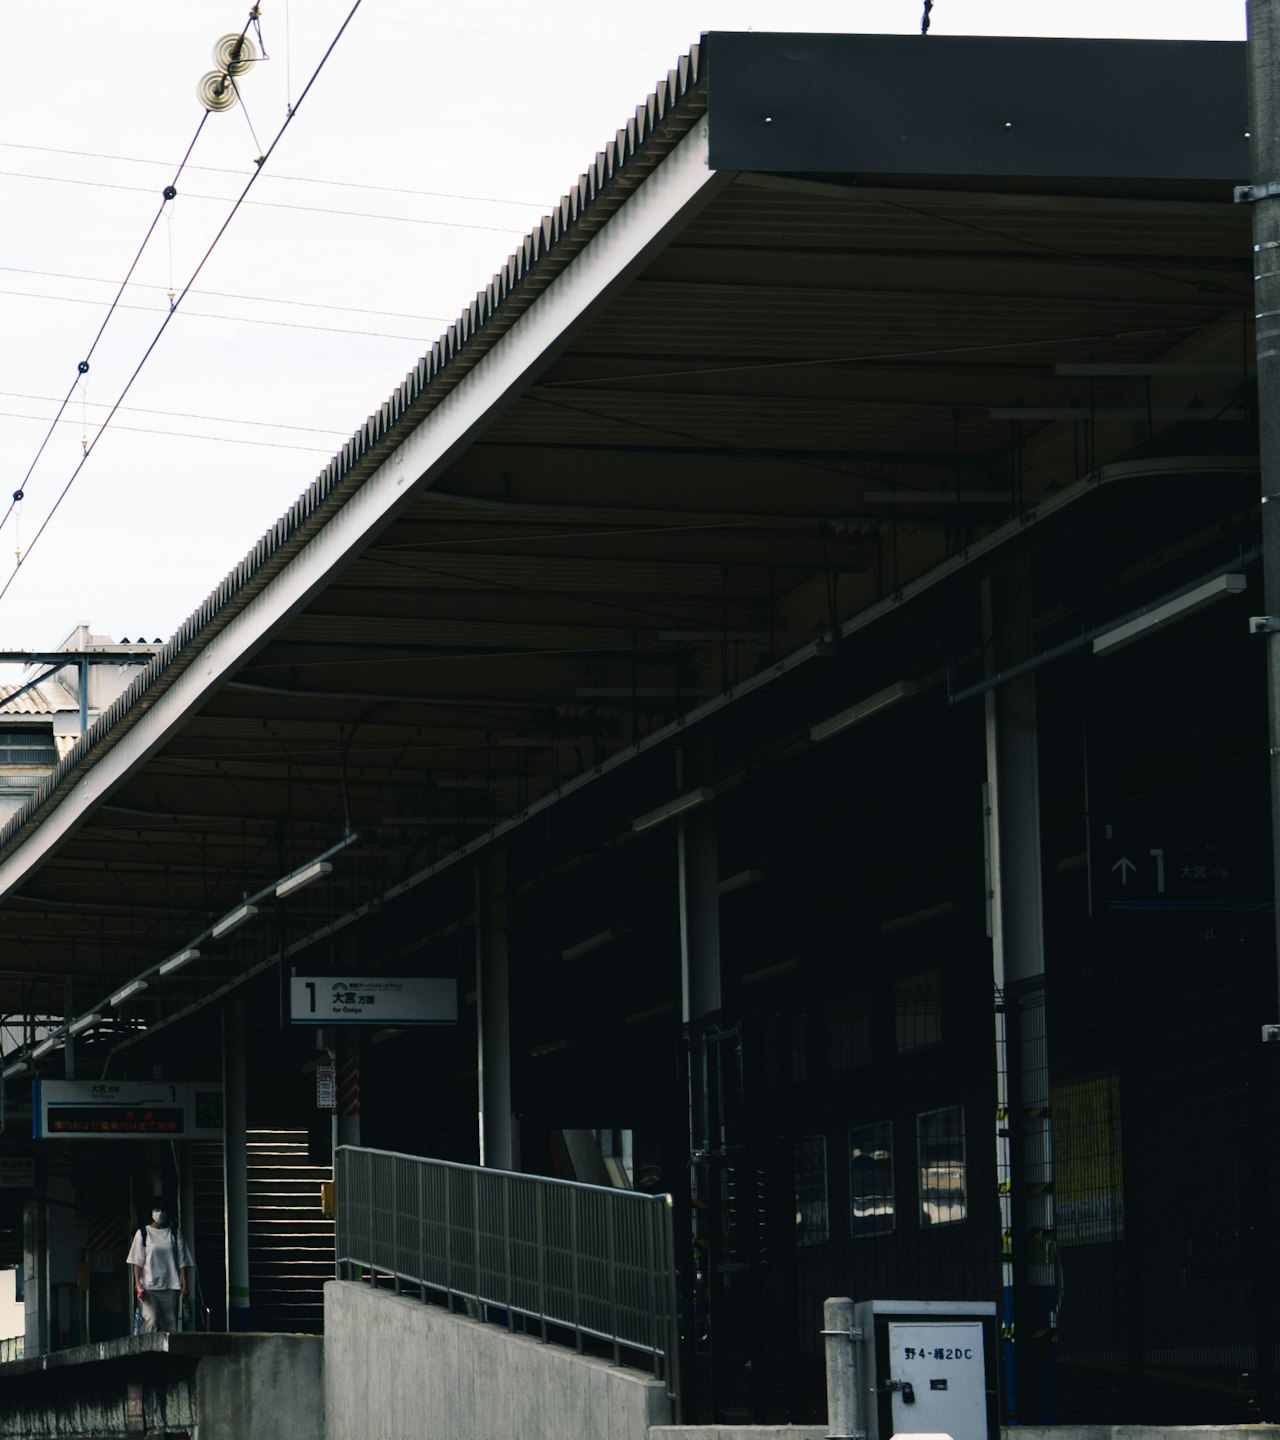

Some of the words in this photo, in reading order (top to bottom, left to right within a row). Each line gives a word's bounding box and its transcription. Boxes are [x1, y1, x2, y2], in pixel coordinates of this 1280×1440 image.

[1149, 848, 1165, 893] 1
[305, 982, 316, 1013] 1
[332, 992, 357, 1005] 大宮
[168, 1085, 177, 1103] 1
